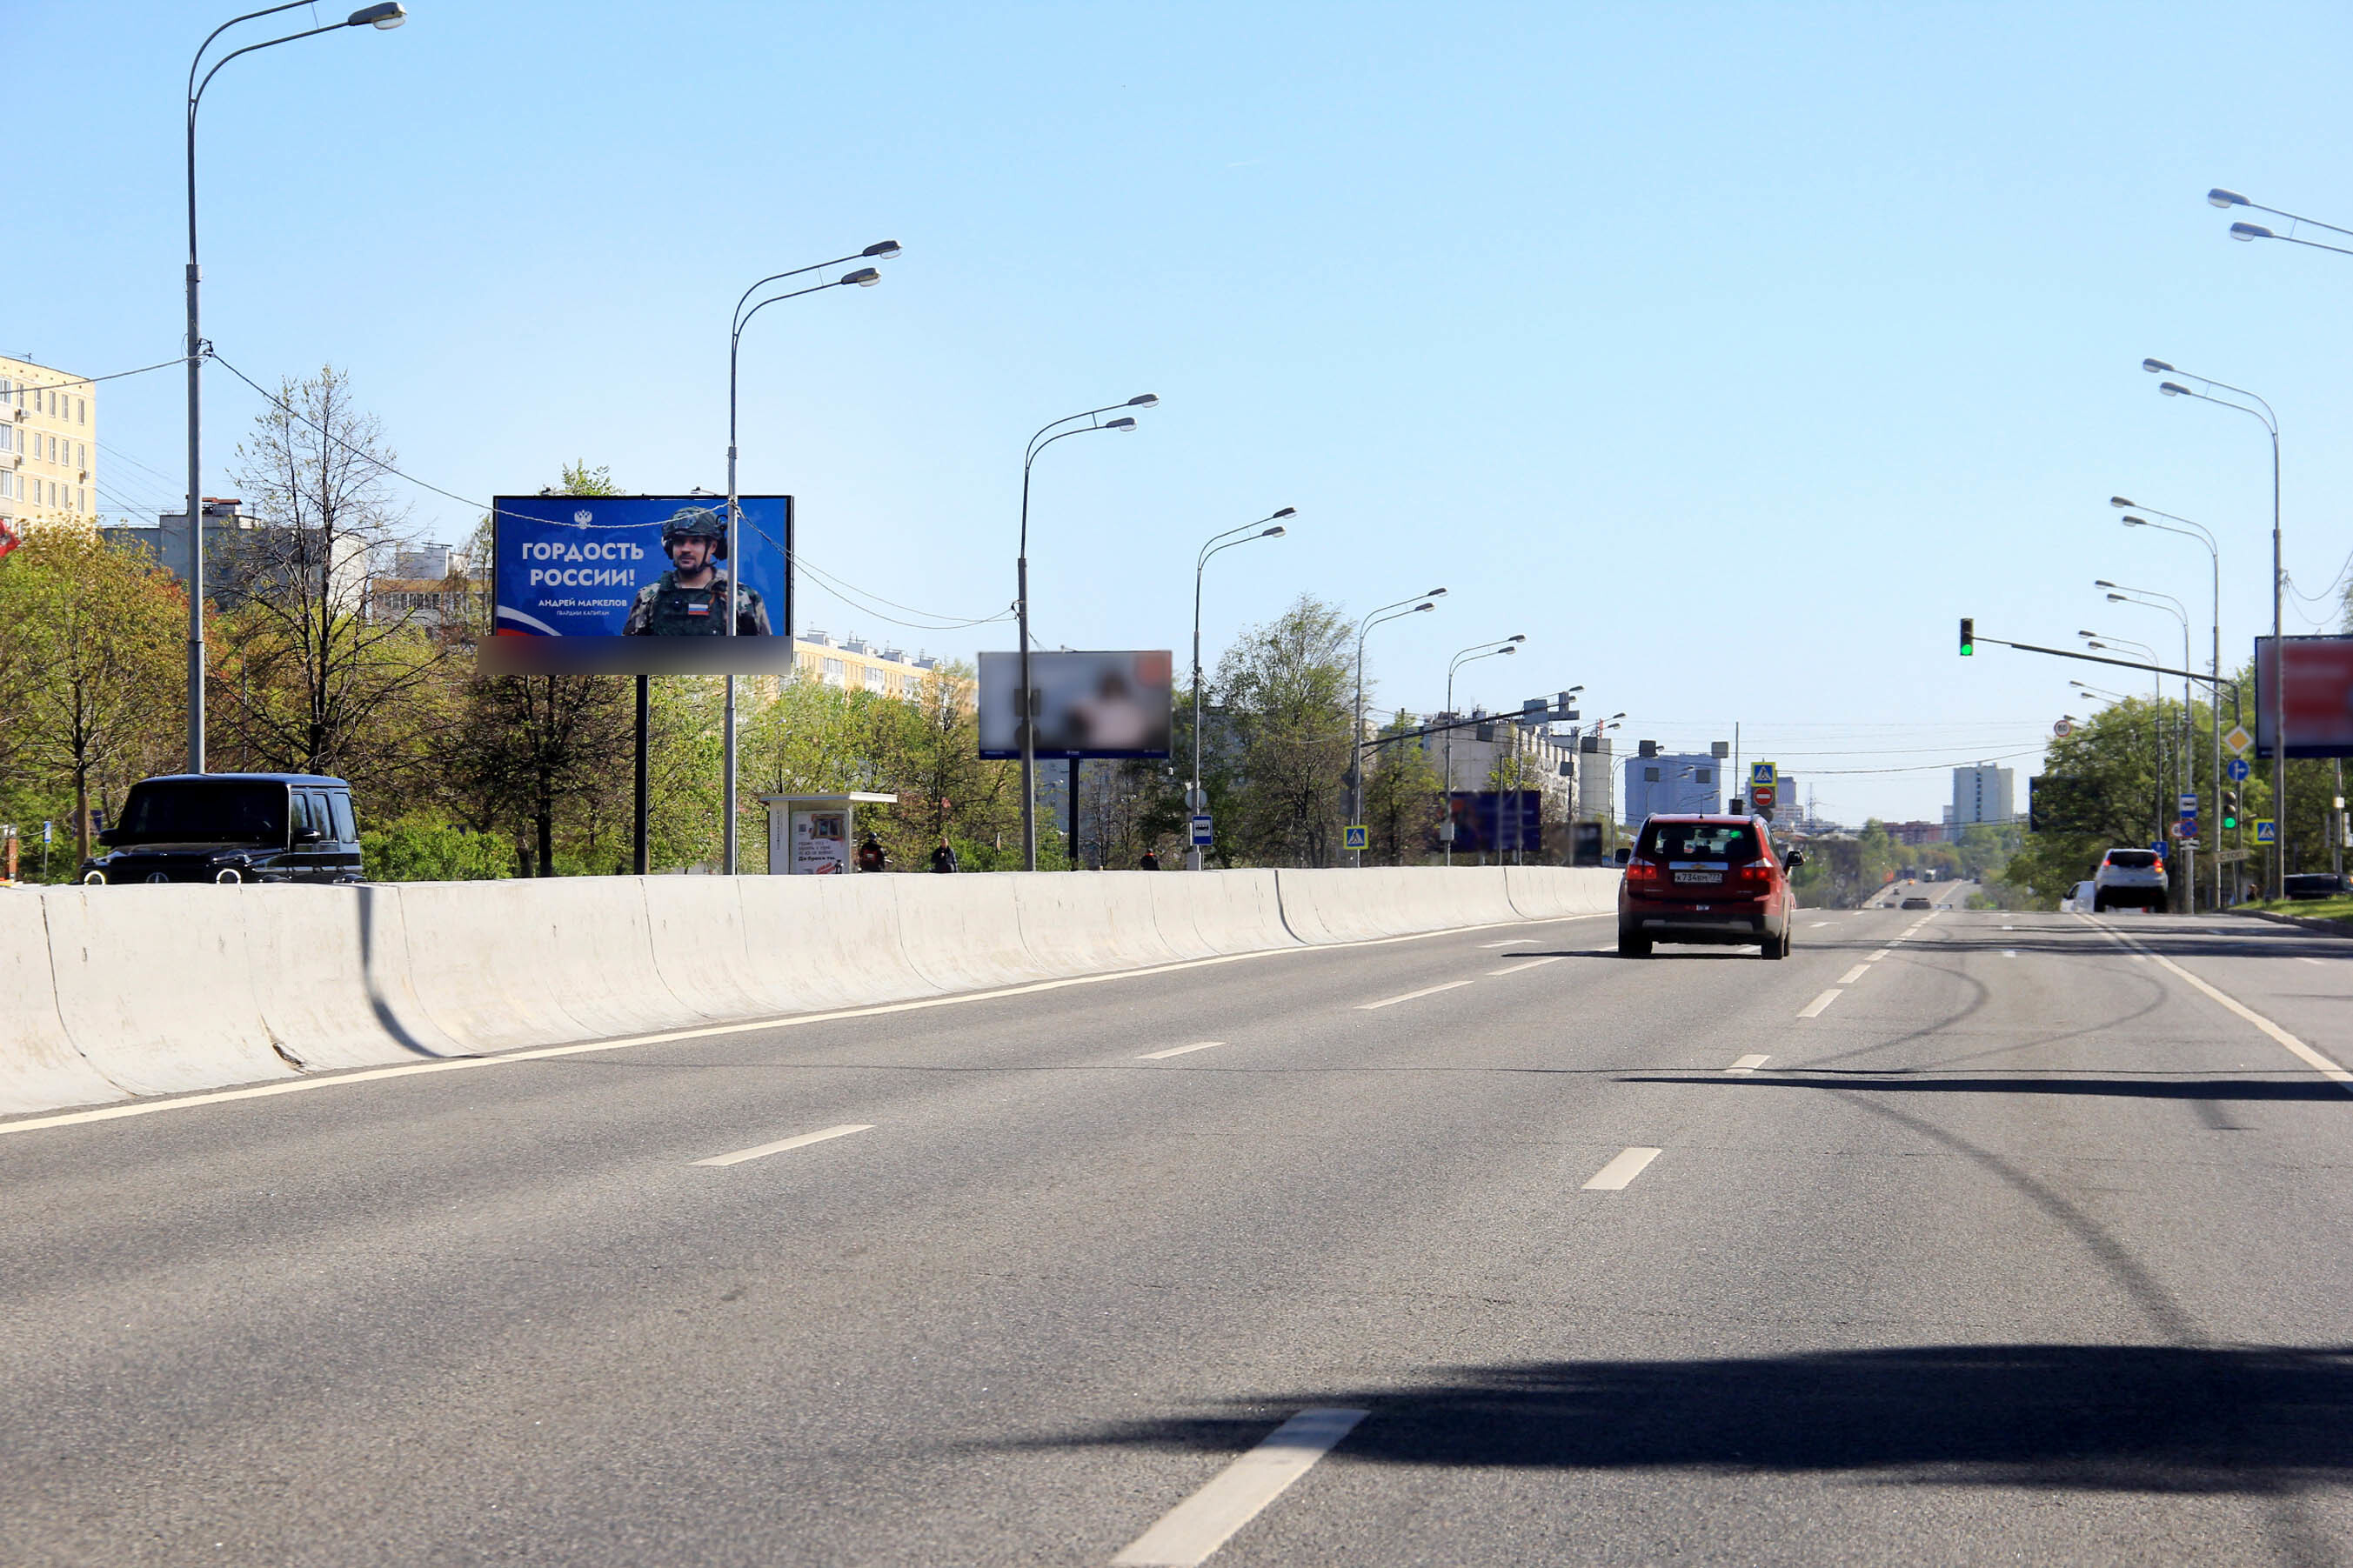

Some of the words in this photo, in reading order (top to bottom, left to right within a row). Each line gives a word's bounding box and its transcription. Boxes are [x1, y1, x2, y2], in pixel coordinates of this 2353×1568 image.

[522, 543, 644, 563] ГОРДОСТЬ
[530, 569, 635, 586] РОССИИ!
[538, 598, 576, 607] АНДРЕЙ
